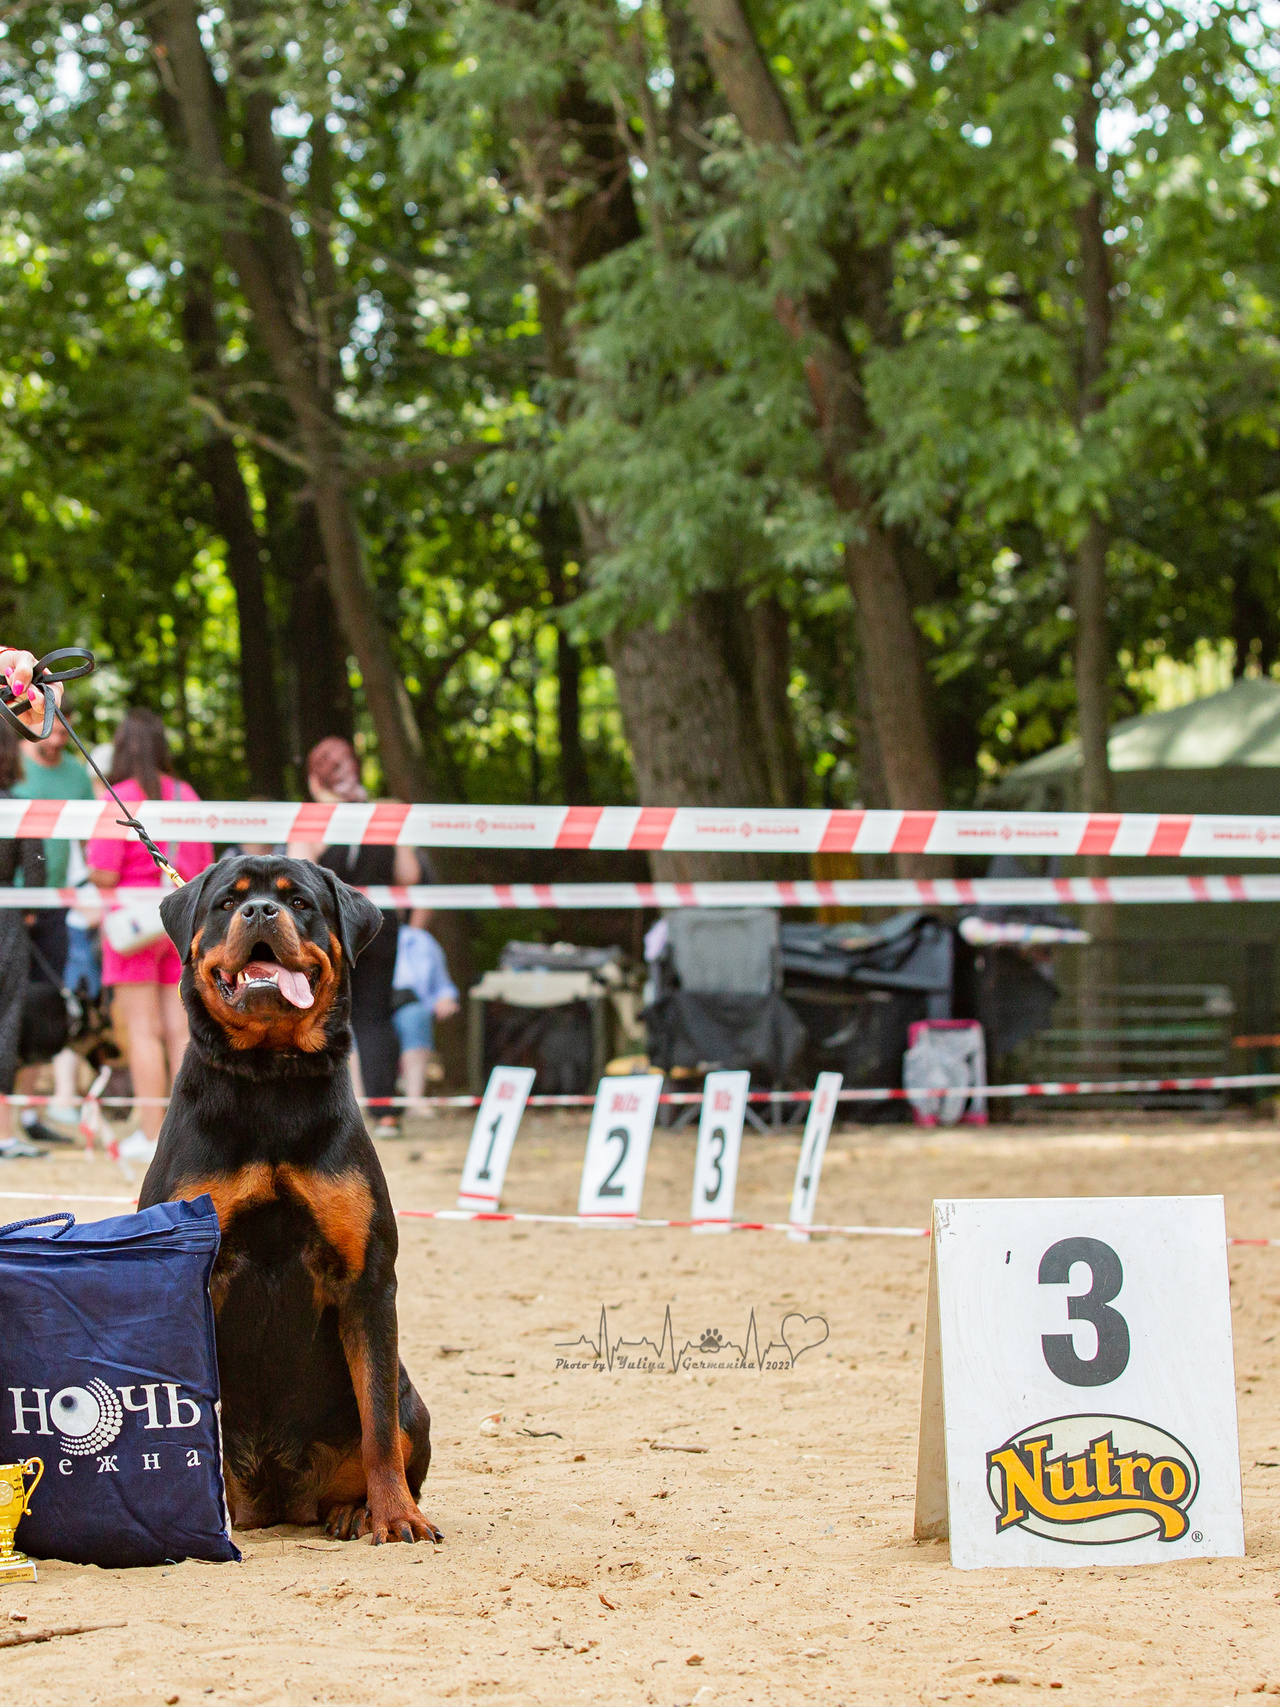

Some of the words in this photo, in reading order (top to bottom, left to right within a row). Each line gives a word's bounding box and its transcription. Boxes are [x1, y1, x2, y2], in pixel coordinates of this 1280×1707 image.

[477, 1113, 503, 1179] 1
[598, 1127, 629, 1197] 2
[704, 1127, 726, 1203] 3
[1038, 1236, 1131, 1387] 3
[8, 1383, 202, 1437] НОЧЬ
[988, 1434, 1190, 1540] Nutro
